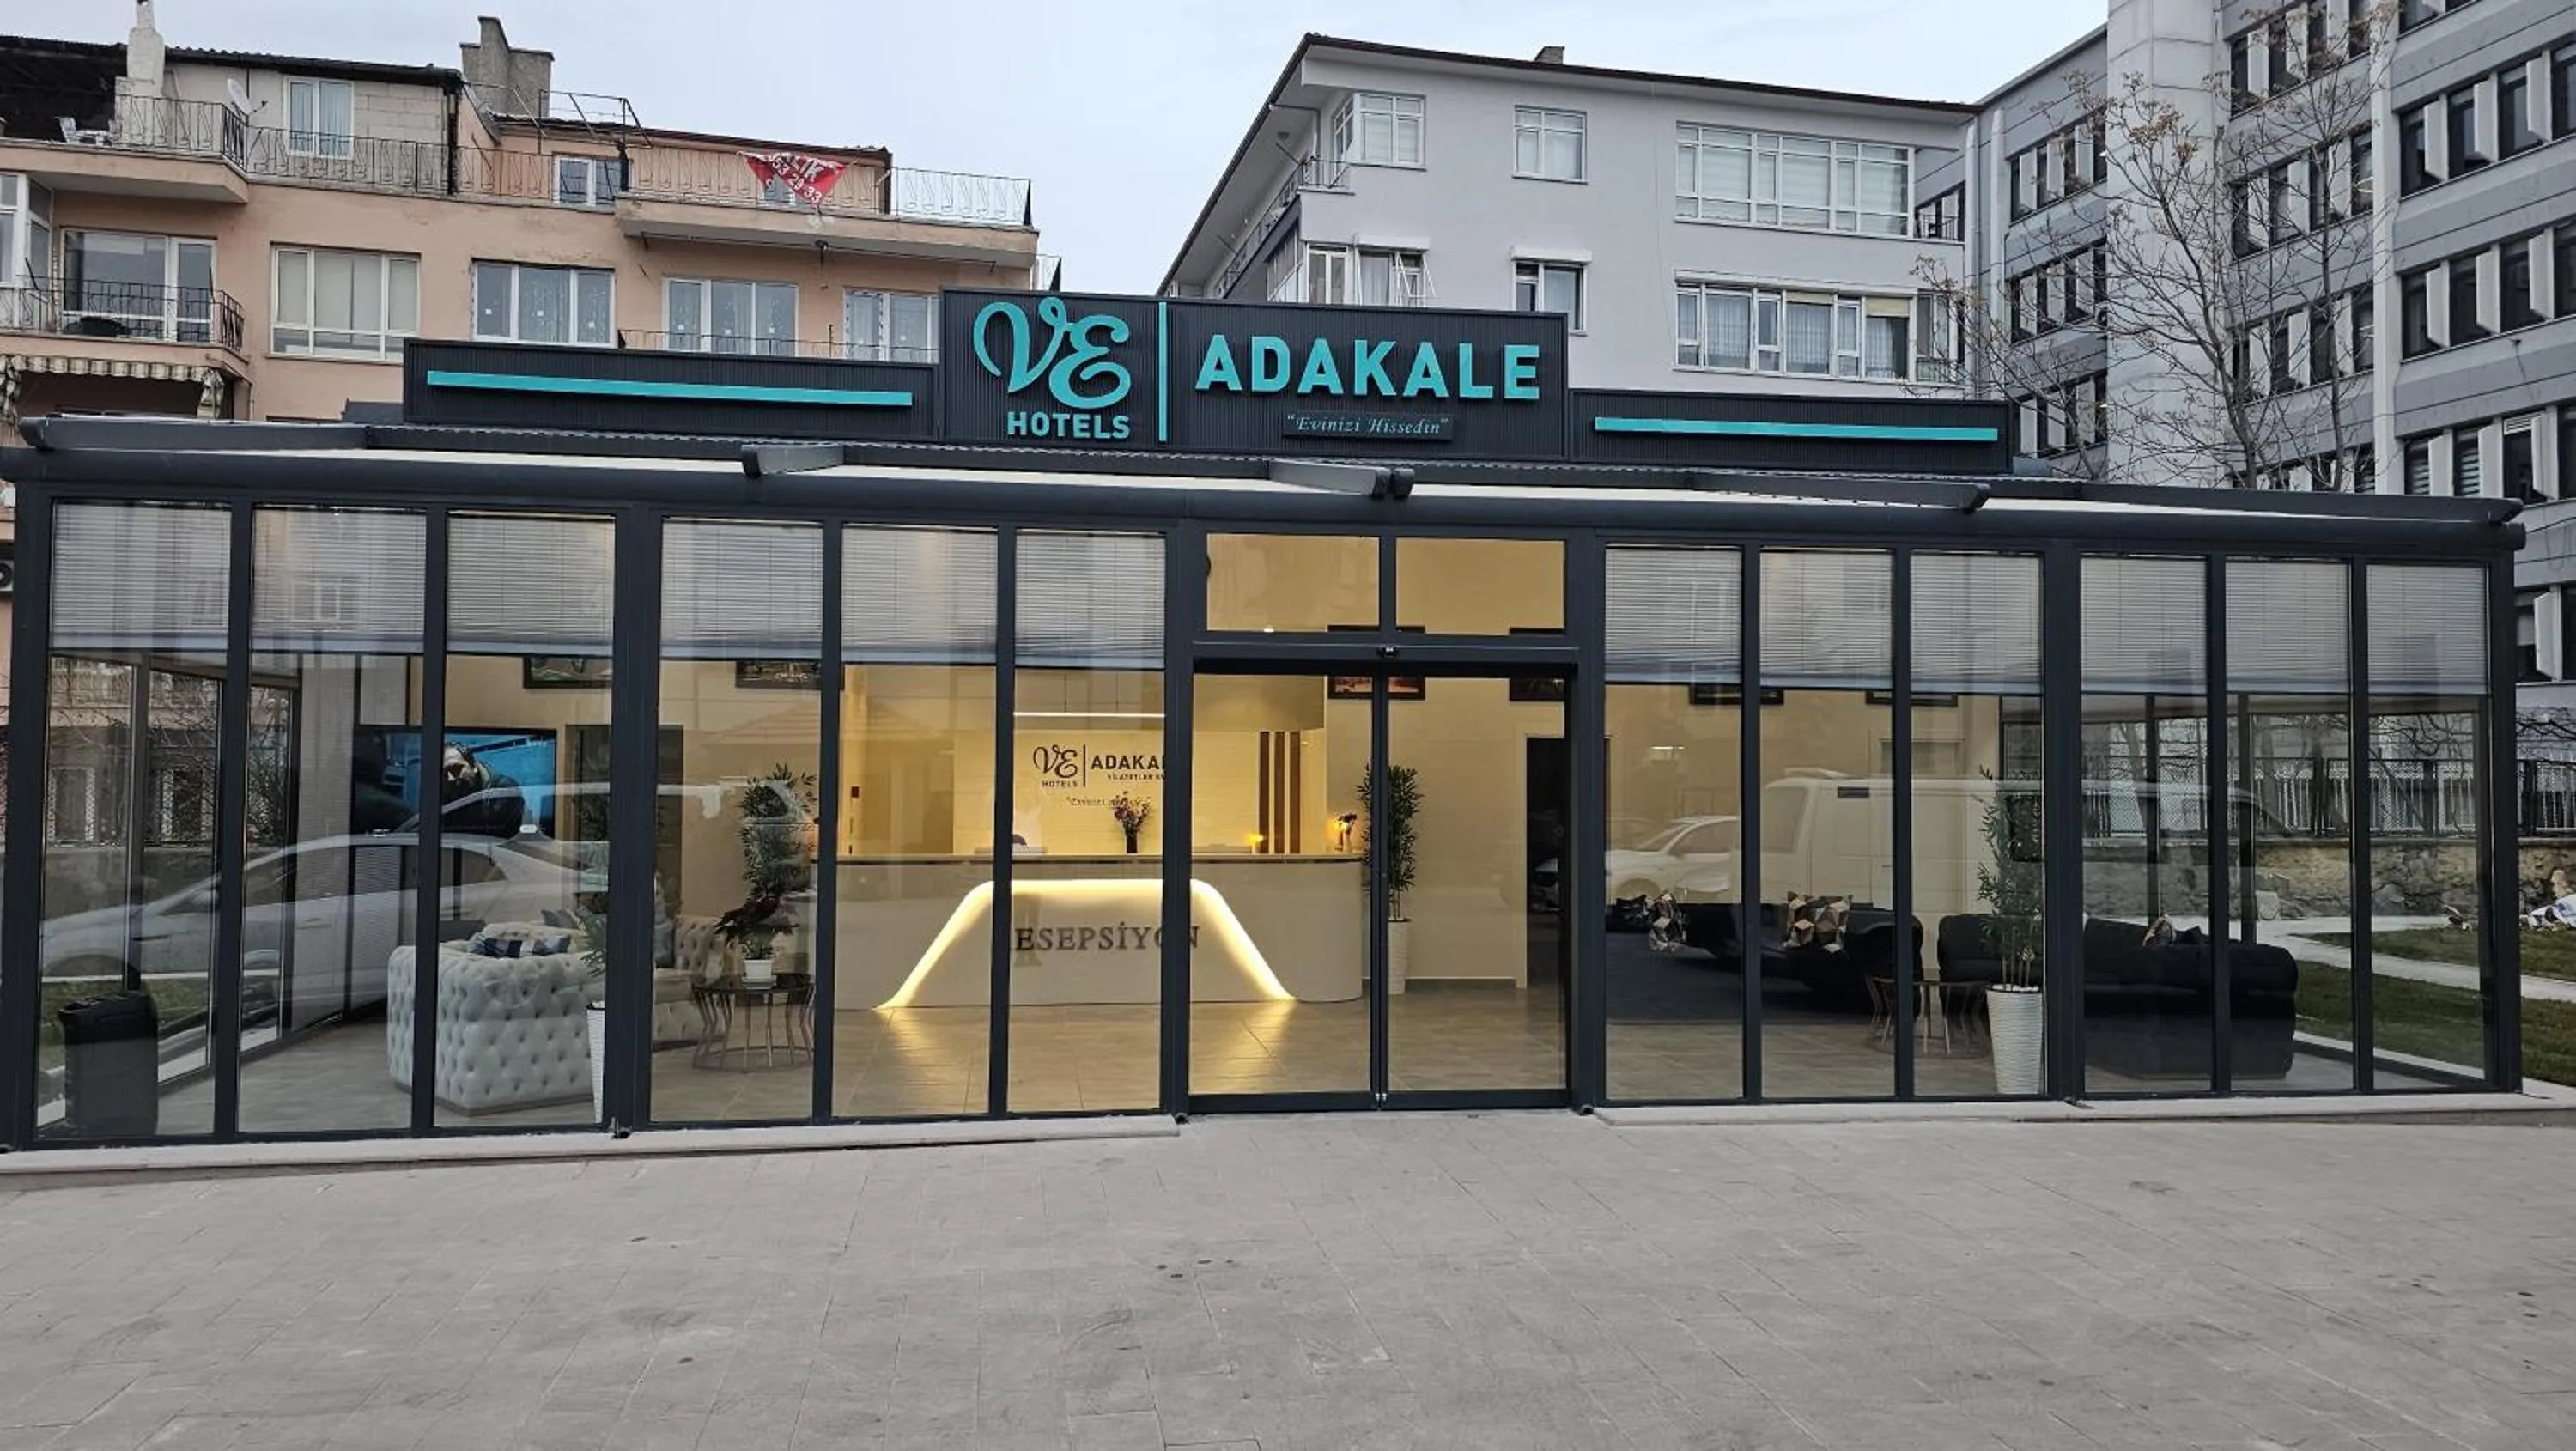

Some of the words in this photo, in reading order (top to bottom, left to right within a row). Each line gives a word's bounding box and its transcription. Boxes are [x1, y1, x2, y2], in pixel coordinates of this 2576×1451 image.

[804, 185, 823, 203] 33
[973, 296, 1132, 410] VE
[1194, 333, 1540, 401] ADAKALE
[1006, 411, 1131, 440] HOTELS
[1033, 744, 1078, 779] VE
[1090, 754, 1166, 771] ADAKA
[1042, 780, 1078, 788] HOTELS
